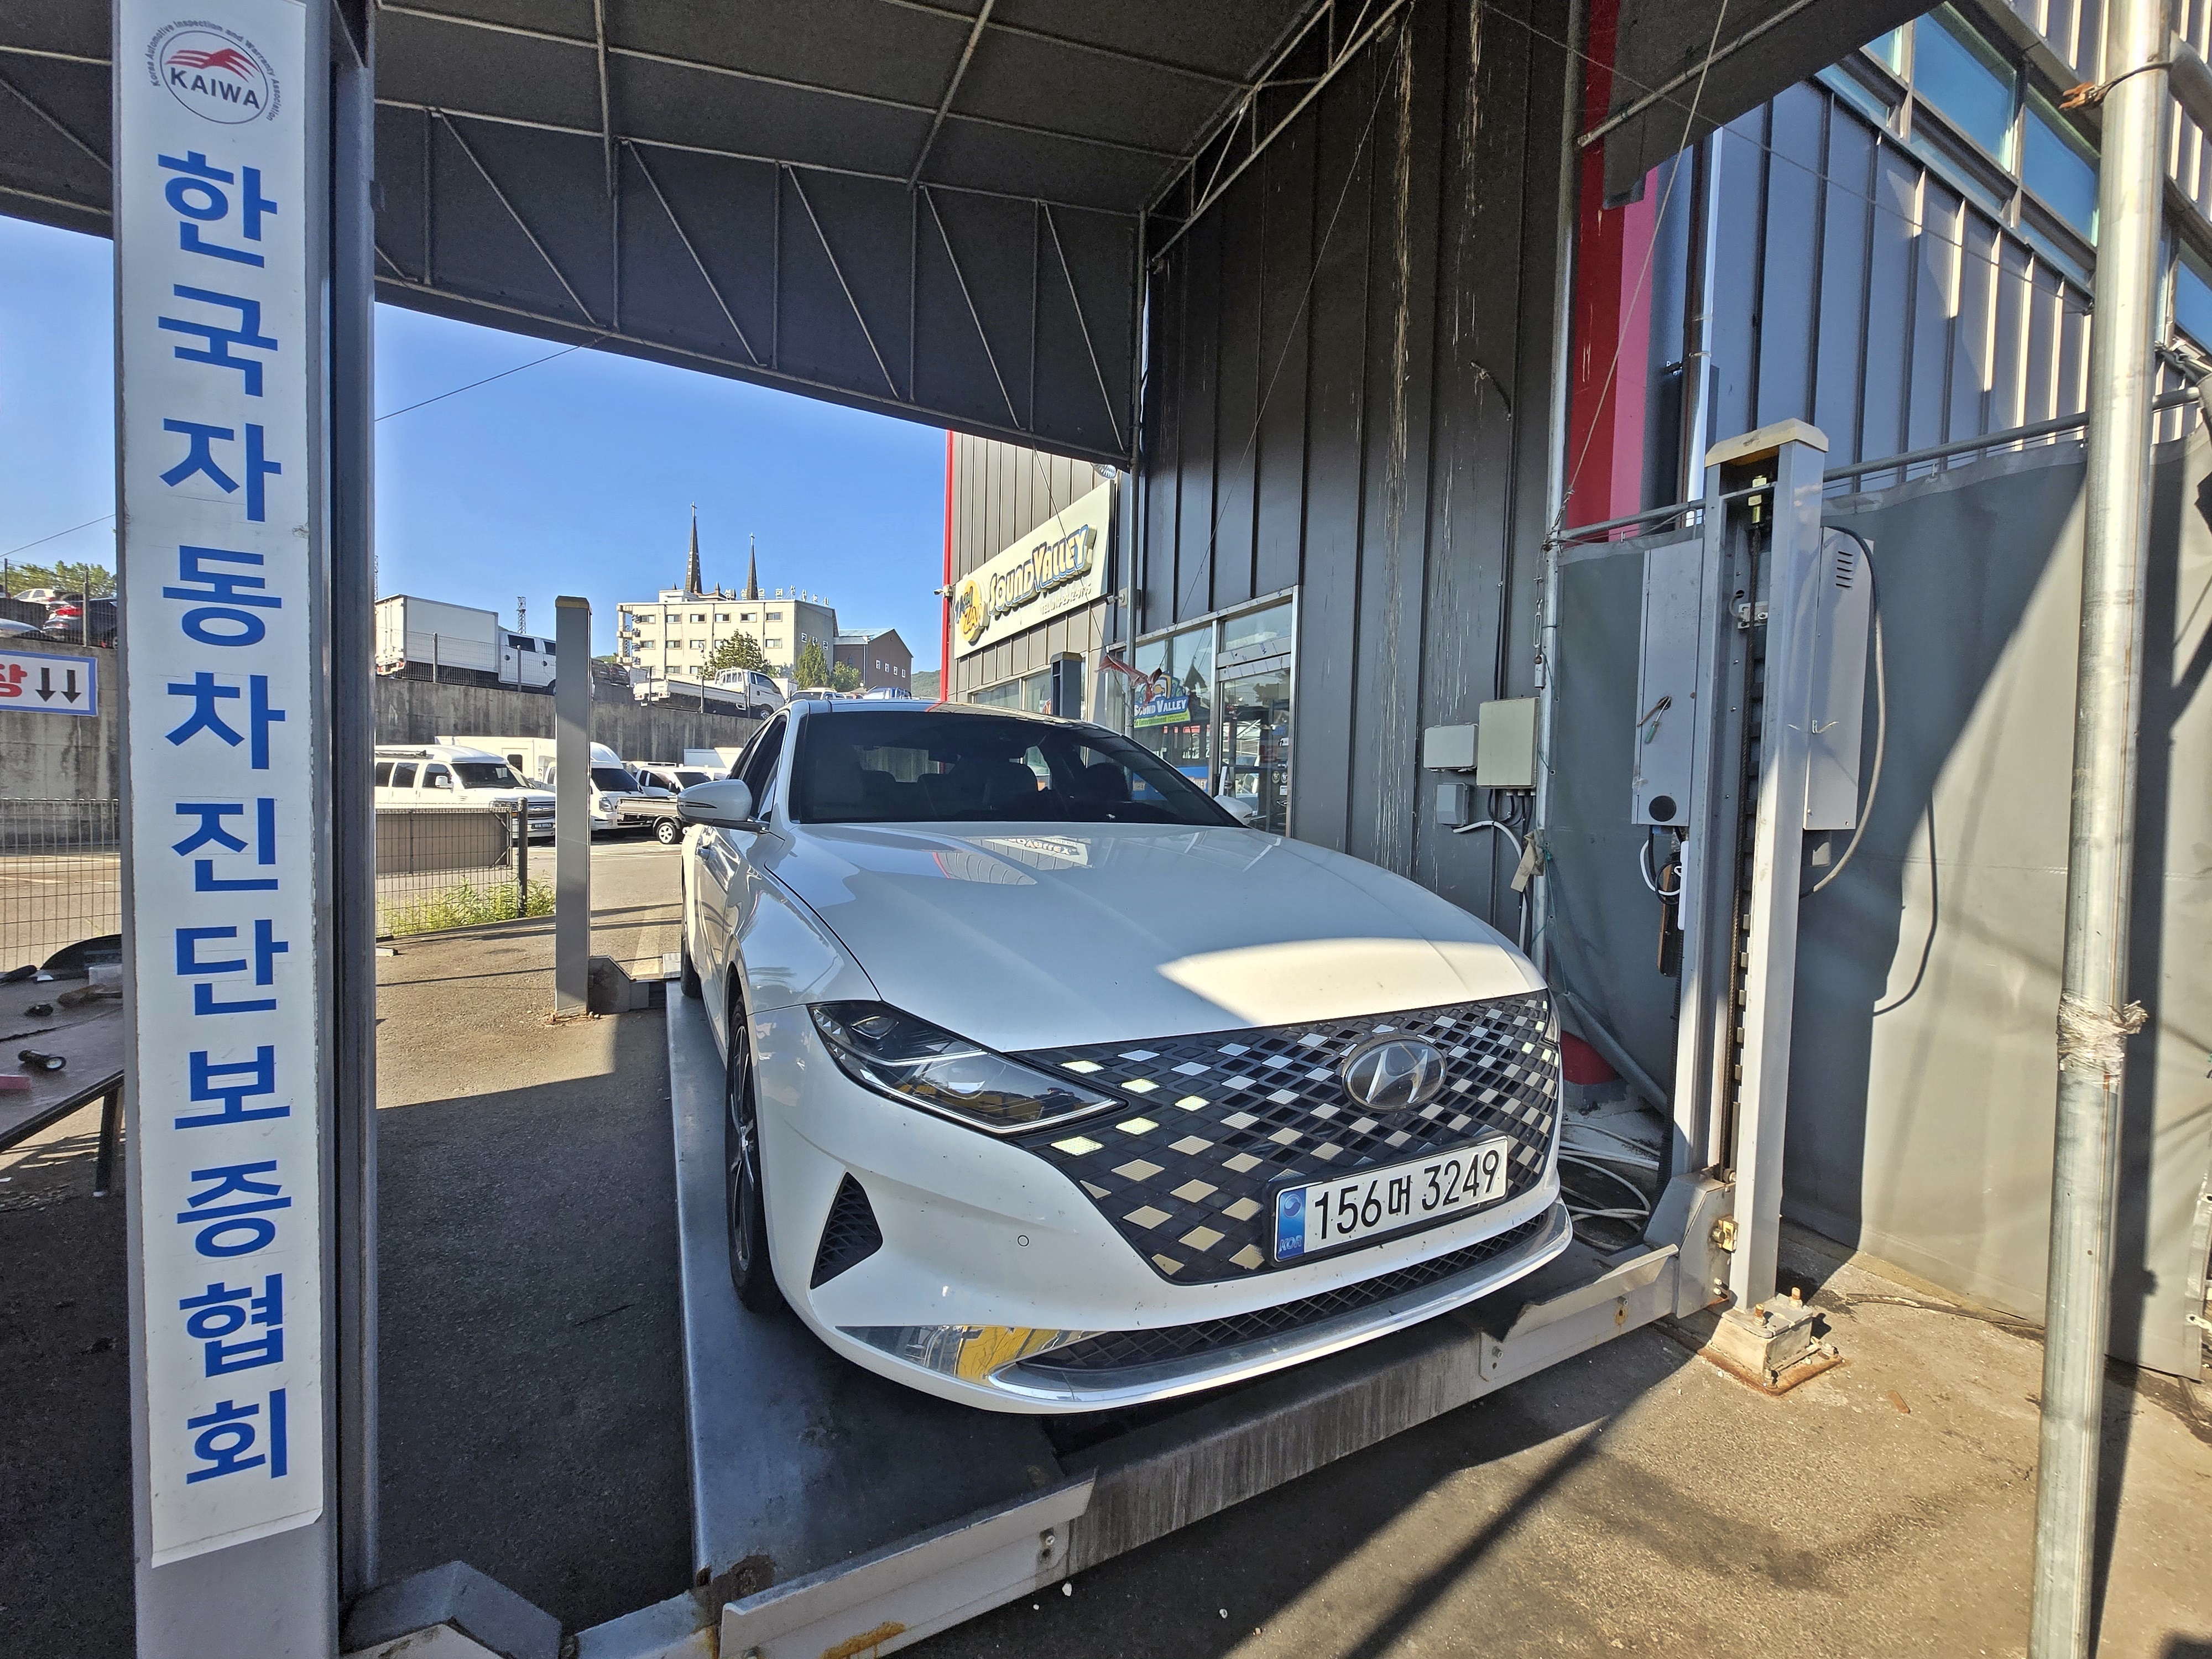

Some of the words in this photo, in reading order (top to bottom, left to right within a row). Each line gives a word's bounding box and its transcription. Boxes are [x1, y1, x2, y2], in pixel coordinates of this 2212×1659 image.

[145, 24, 175, 60] Automotive
[173, 20, 223, 32] Inspection
[225, 29, 243, 42] and
[147, 61, 160, 86] Korea
[245, 40, 275, 76] Warranty
[170, 67, 260, 110] KAIWA
[267, 77, 281, 121] Association
[1156, 699, 1187, 713] VALLEY
[157, 150, 292, 1485] 한국자동차진단보증협회
[1314, 1175, 1411, 1240] 156머
[1421, 1150, 1499, 1211] 3249
[1279, 1235, 1302, 1254] KOR
